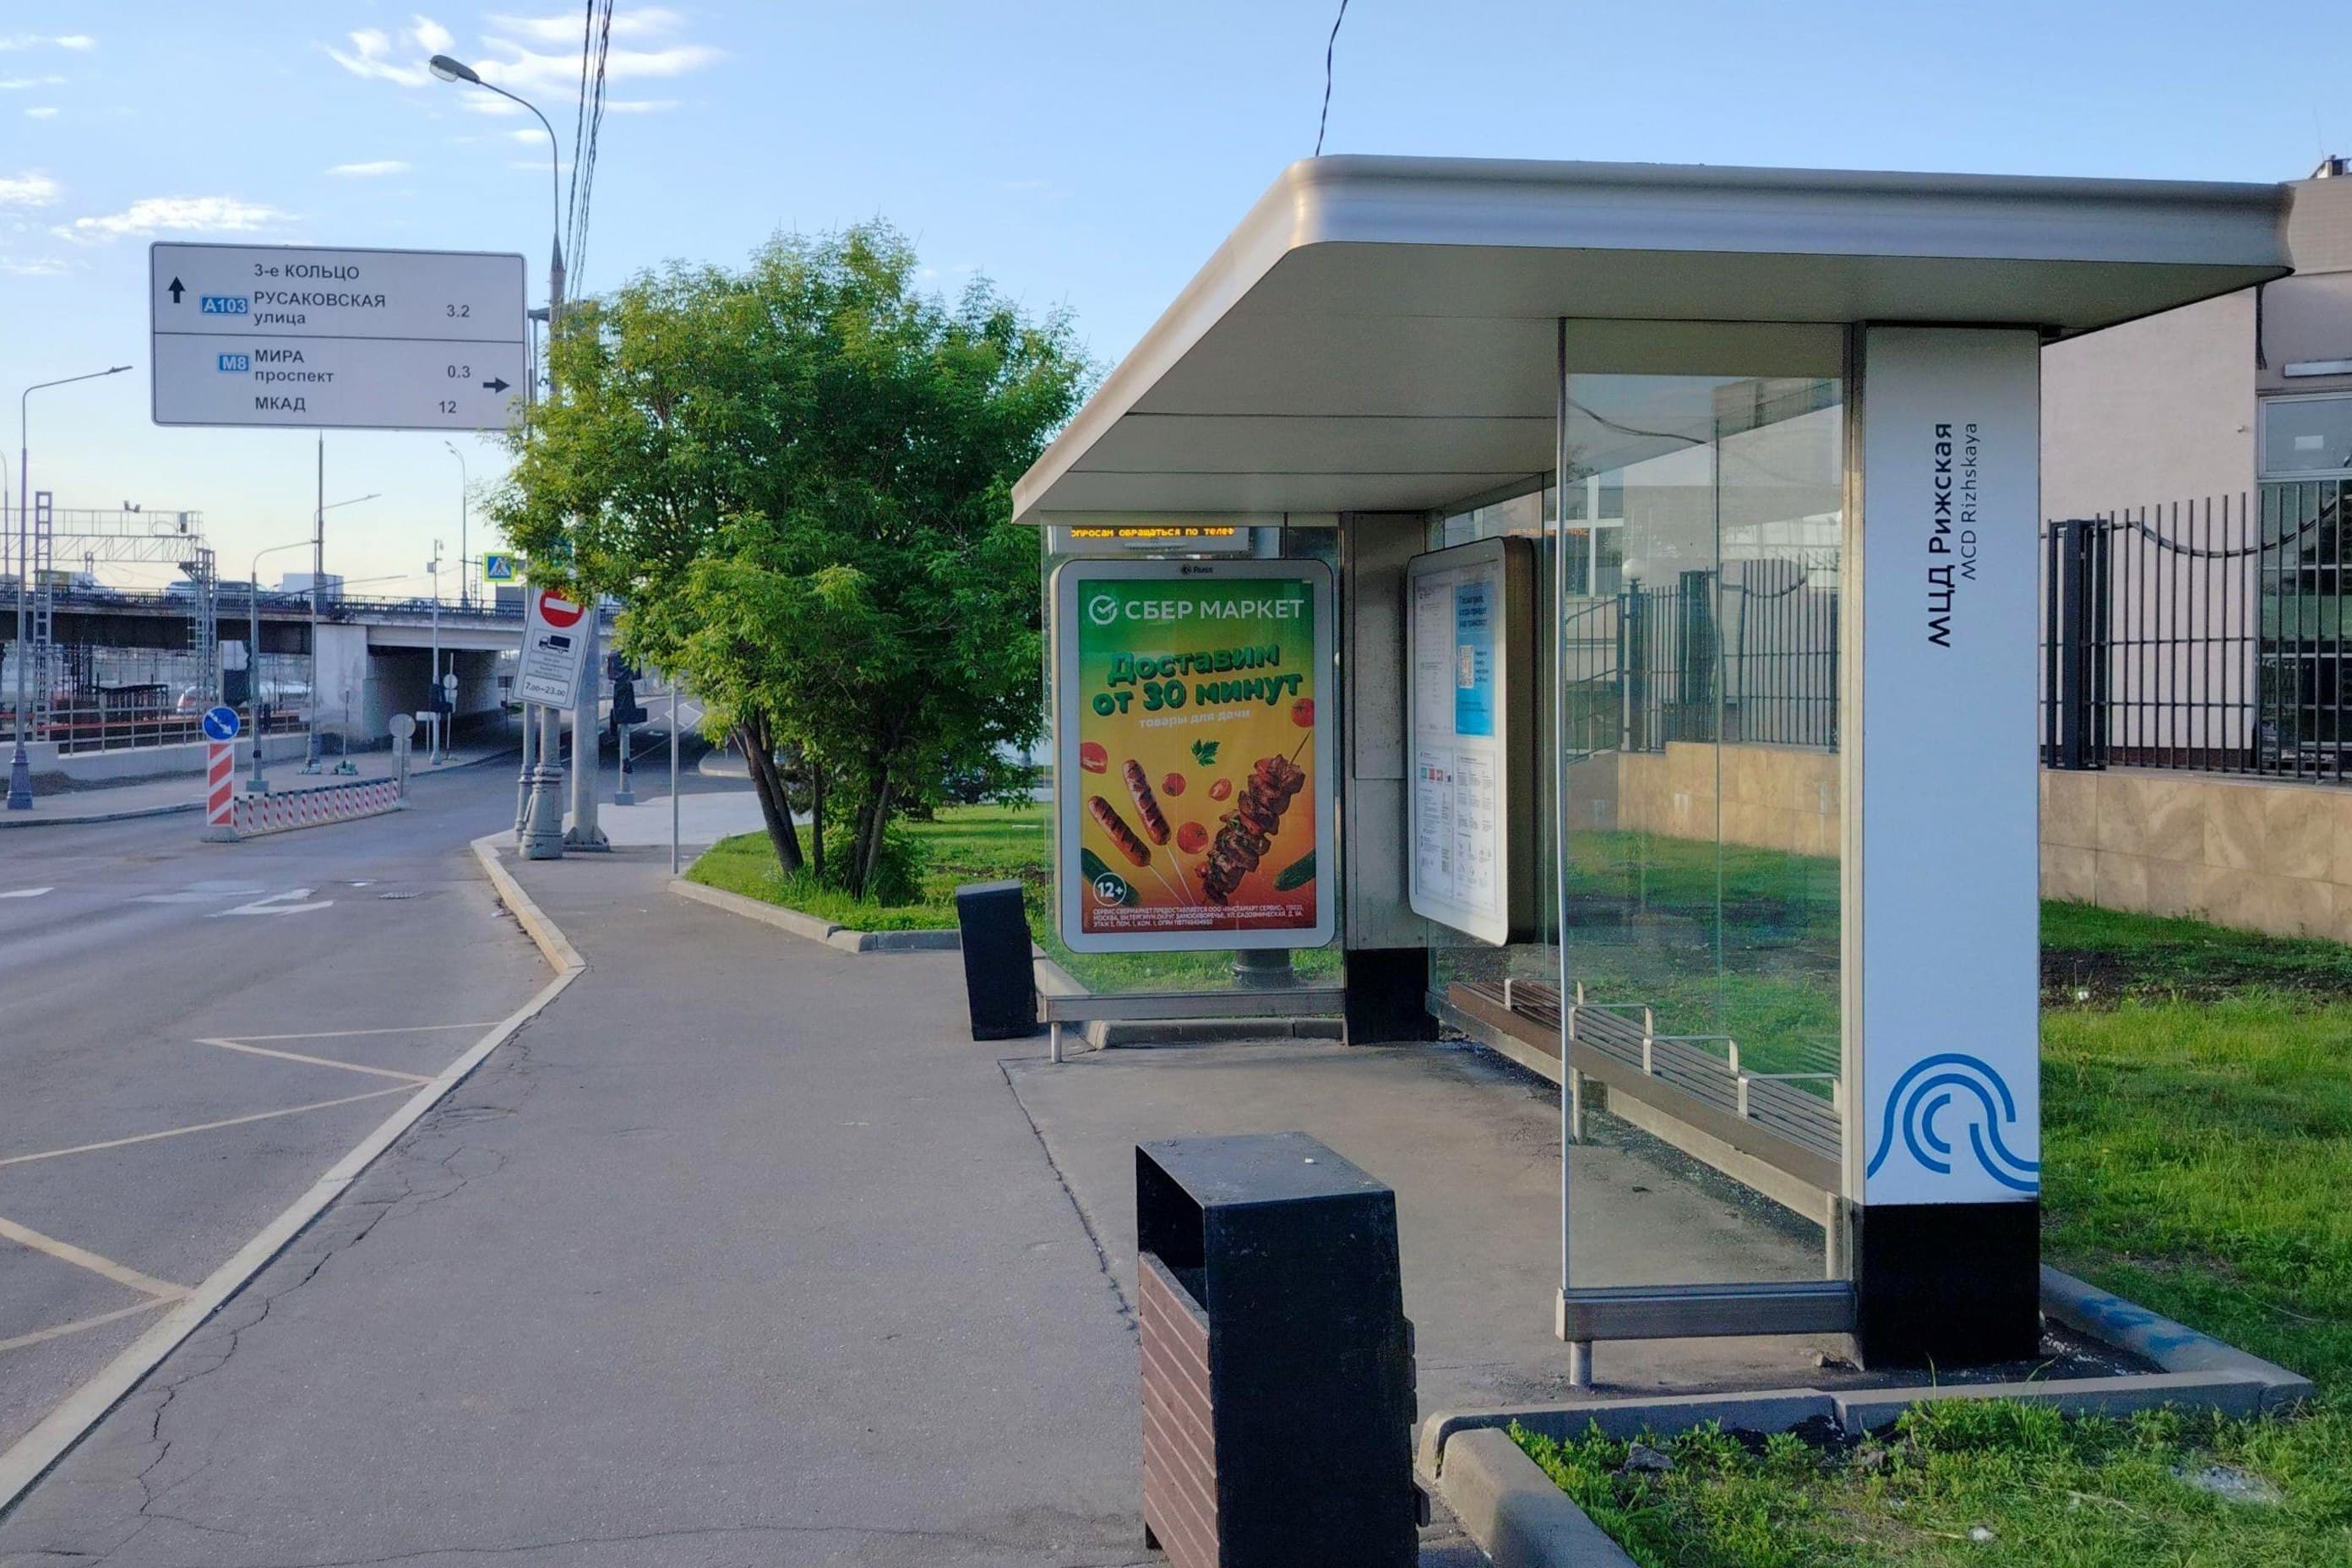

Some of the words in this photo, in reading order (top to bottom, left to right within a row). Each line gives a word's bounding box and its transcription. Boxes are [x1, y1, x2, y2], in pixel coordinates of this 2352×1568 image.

[253, 264, 279, 277] 3-е
[286, 264, 360, 281] КОЛЬЦО
[204, 298, 247, 313] А103
[253, 291, 386, 308] РУСАКОВСКАЯ
[446, 304, 471, 318] 3.2
[253, 313, 307, 327] улица
[221, 356, 248, 371] М8
[254, 349, 305, 363] МИРА
[254, 370, 335, 384] проспект
[447, 365, 471, 379] 0.3
[254, 396, 307, 412] МКАД
[438, 400, 457, 415] 12
[1960, 422, 1981, 523] Rizhskaya
[1928, 423, 1952, 554] Рижская
[1960, 529, 1977, 581] MCD
[1124, 600, 1194, 621] СБЕР
[1199, 598, 1306, 620] МАРКЕТ
[1927, 564, 1956, 648] МЦД
[1107, 643, 1281, 688] Доставим
[1092, 689, 1135, 717] от
[1143, 678, 1187, 711] 30
[1195, 672, 1304, 707] минут
[1138, 715, 1188, 728] товары
[1190, 712, 1215, 725] для
[1218, 708, 1251, 722] дачи
[1097, 881, 1124, 898] 12+
